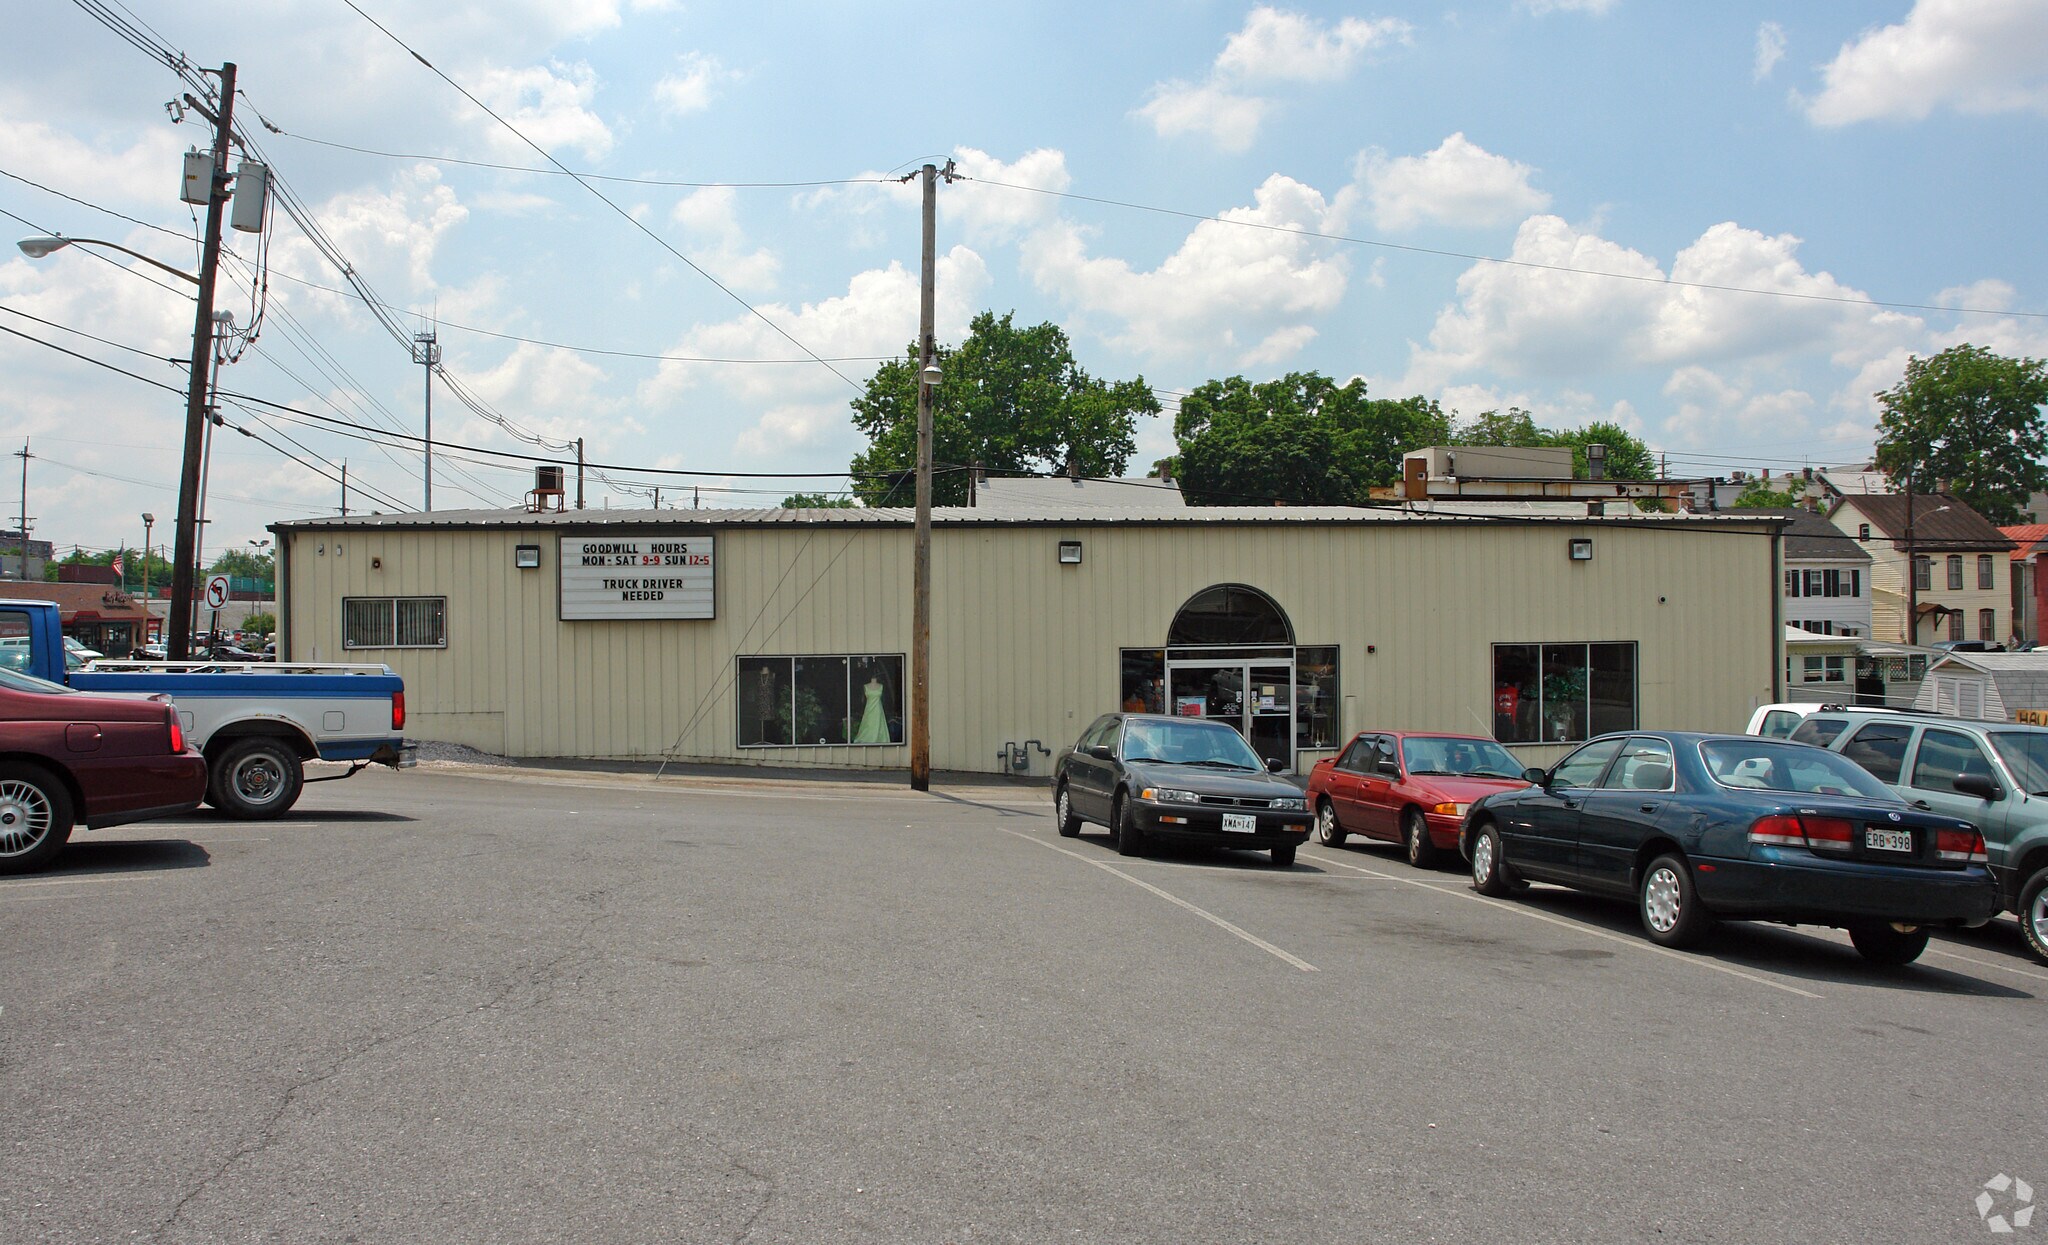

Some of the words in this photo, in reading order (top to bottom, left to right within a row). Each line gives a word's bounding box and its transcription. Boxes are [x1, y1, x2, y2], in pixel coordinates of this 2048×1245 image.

[582, 543, 639, 554] GOODWILL
[651, 543, 688, 554] HOURS
[616, 555, 637, 566] SAT
[642, 555, 661, 565] 9-9
[665, 555, 686, 565] SUN
[689, 555, 710, 565] 12-5
[603, 579, 638, 589] TRUCK
[643, 579, 683, 589] DRIVER
[622, 591, 664, 601] NEEDED
